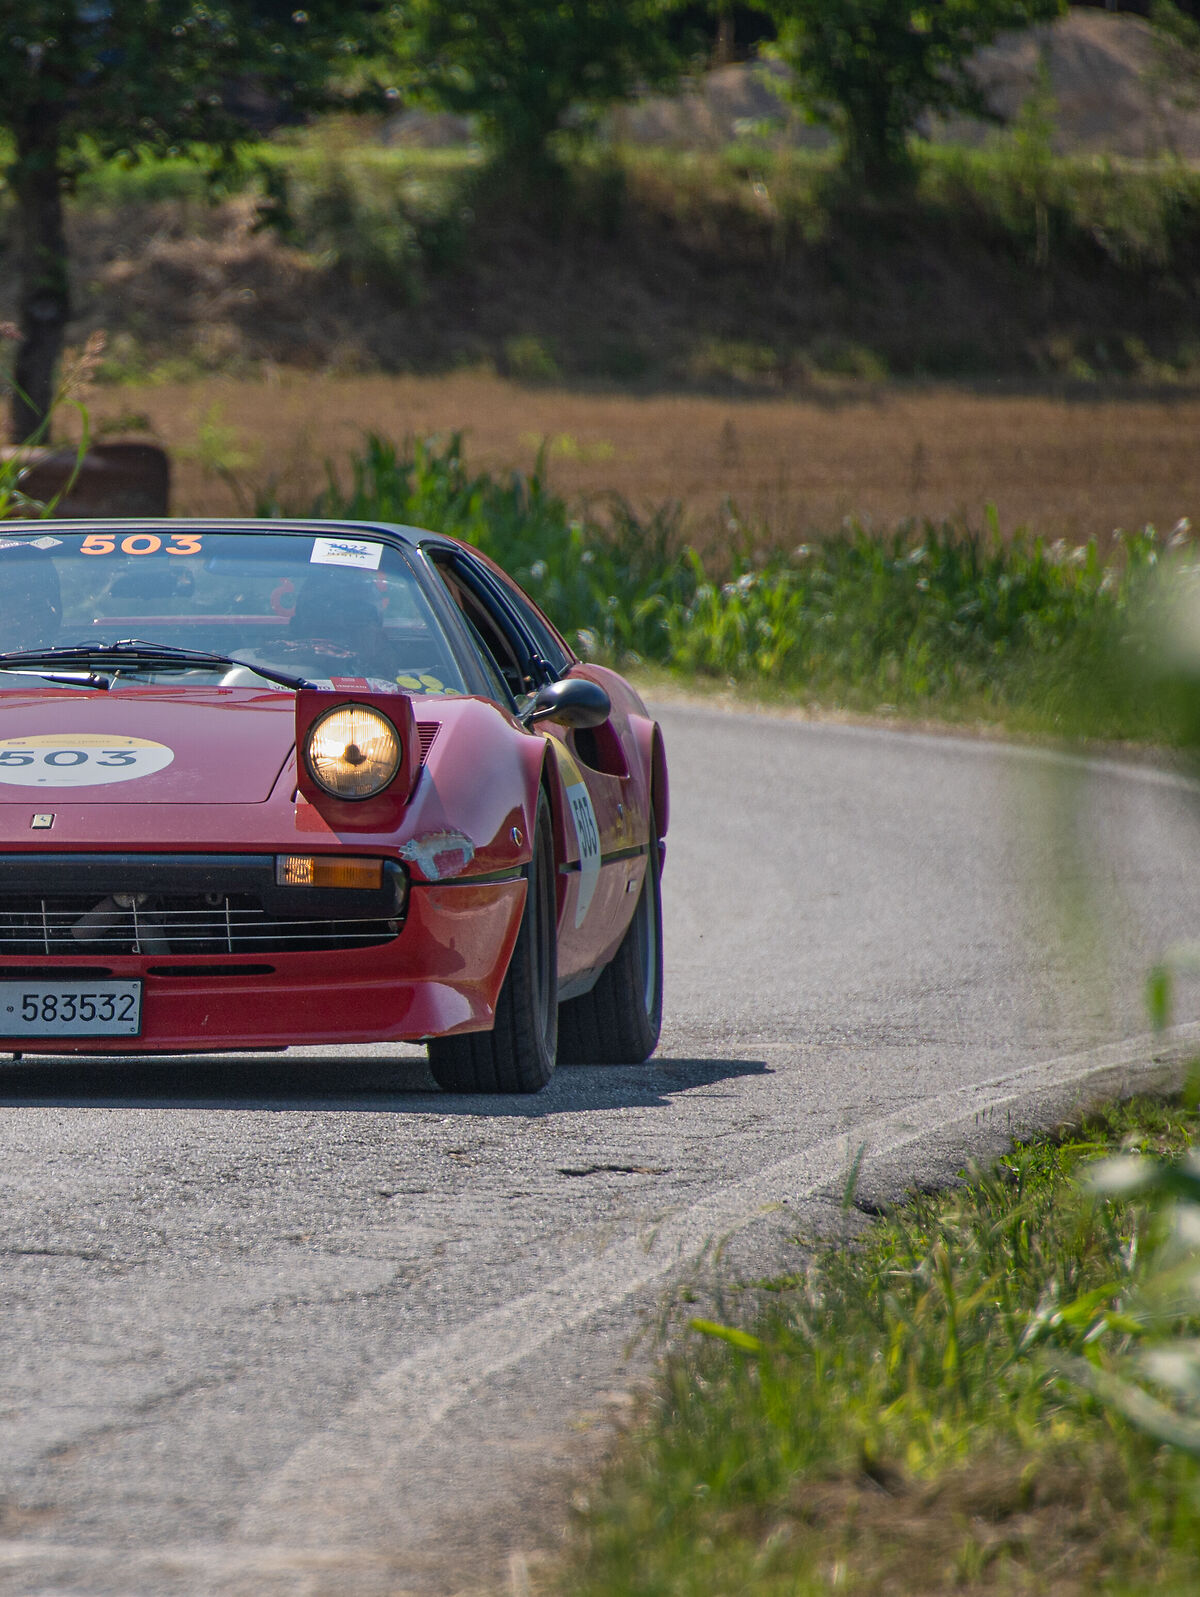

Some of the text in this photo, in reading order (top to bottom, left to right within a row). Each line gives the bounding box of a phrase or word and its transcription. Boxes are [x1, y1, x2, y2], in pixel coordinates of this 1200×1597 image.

[80, 534, 203, 555] 503
[572, 796, 598, 859] 503
[21, 994, 135, 1022] 583532
